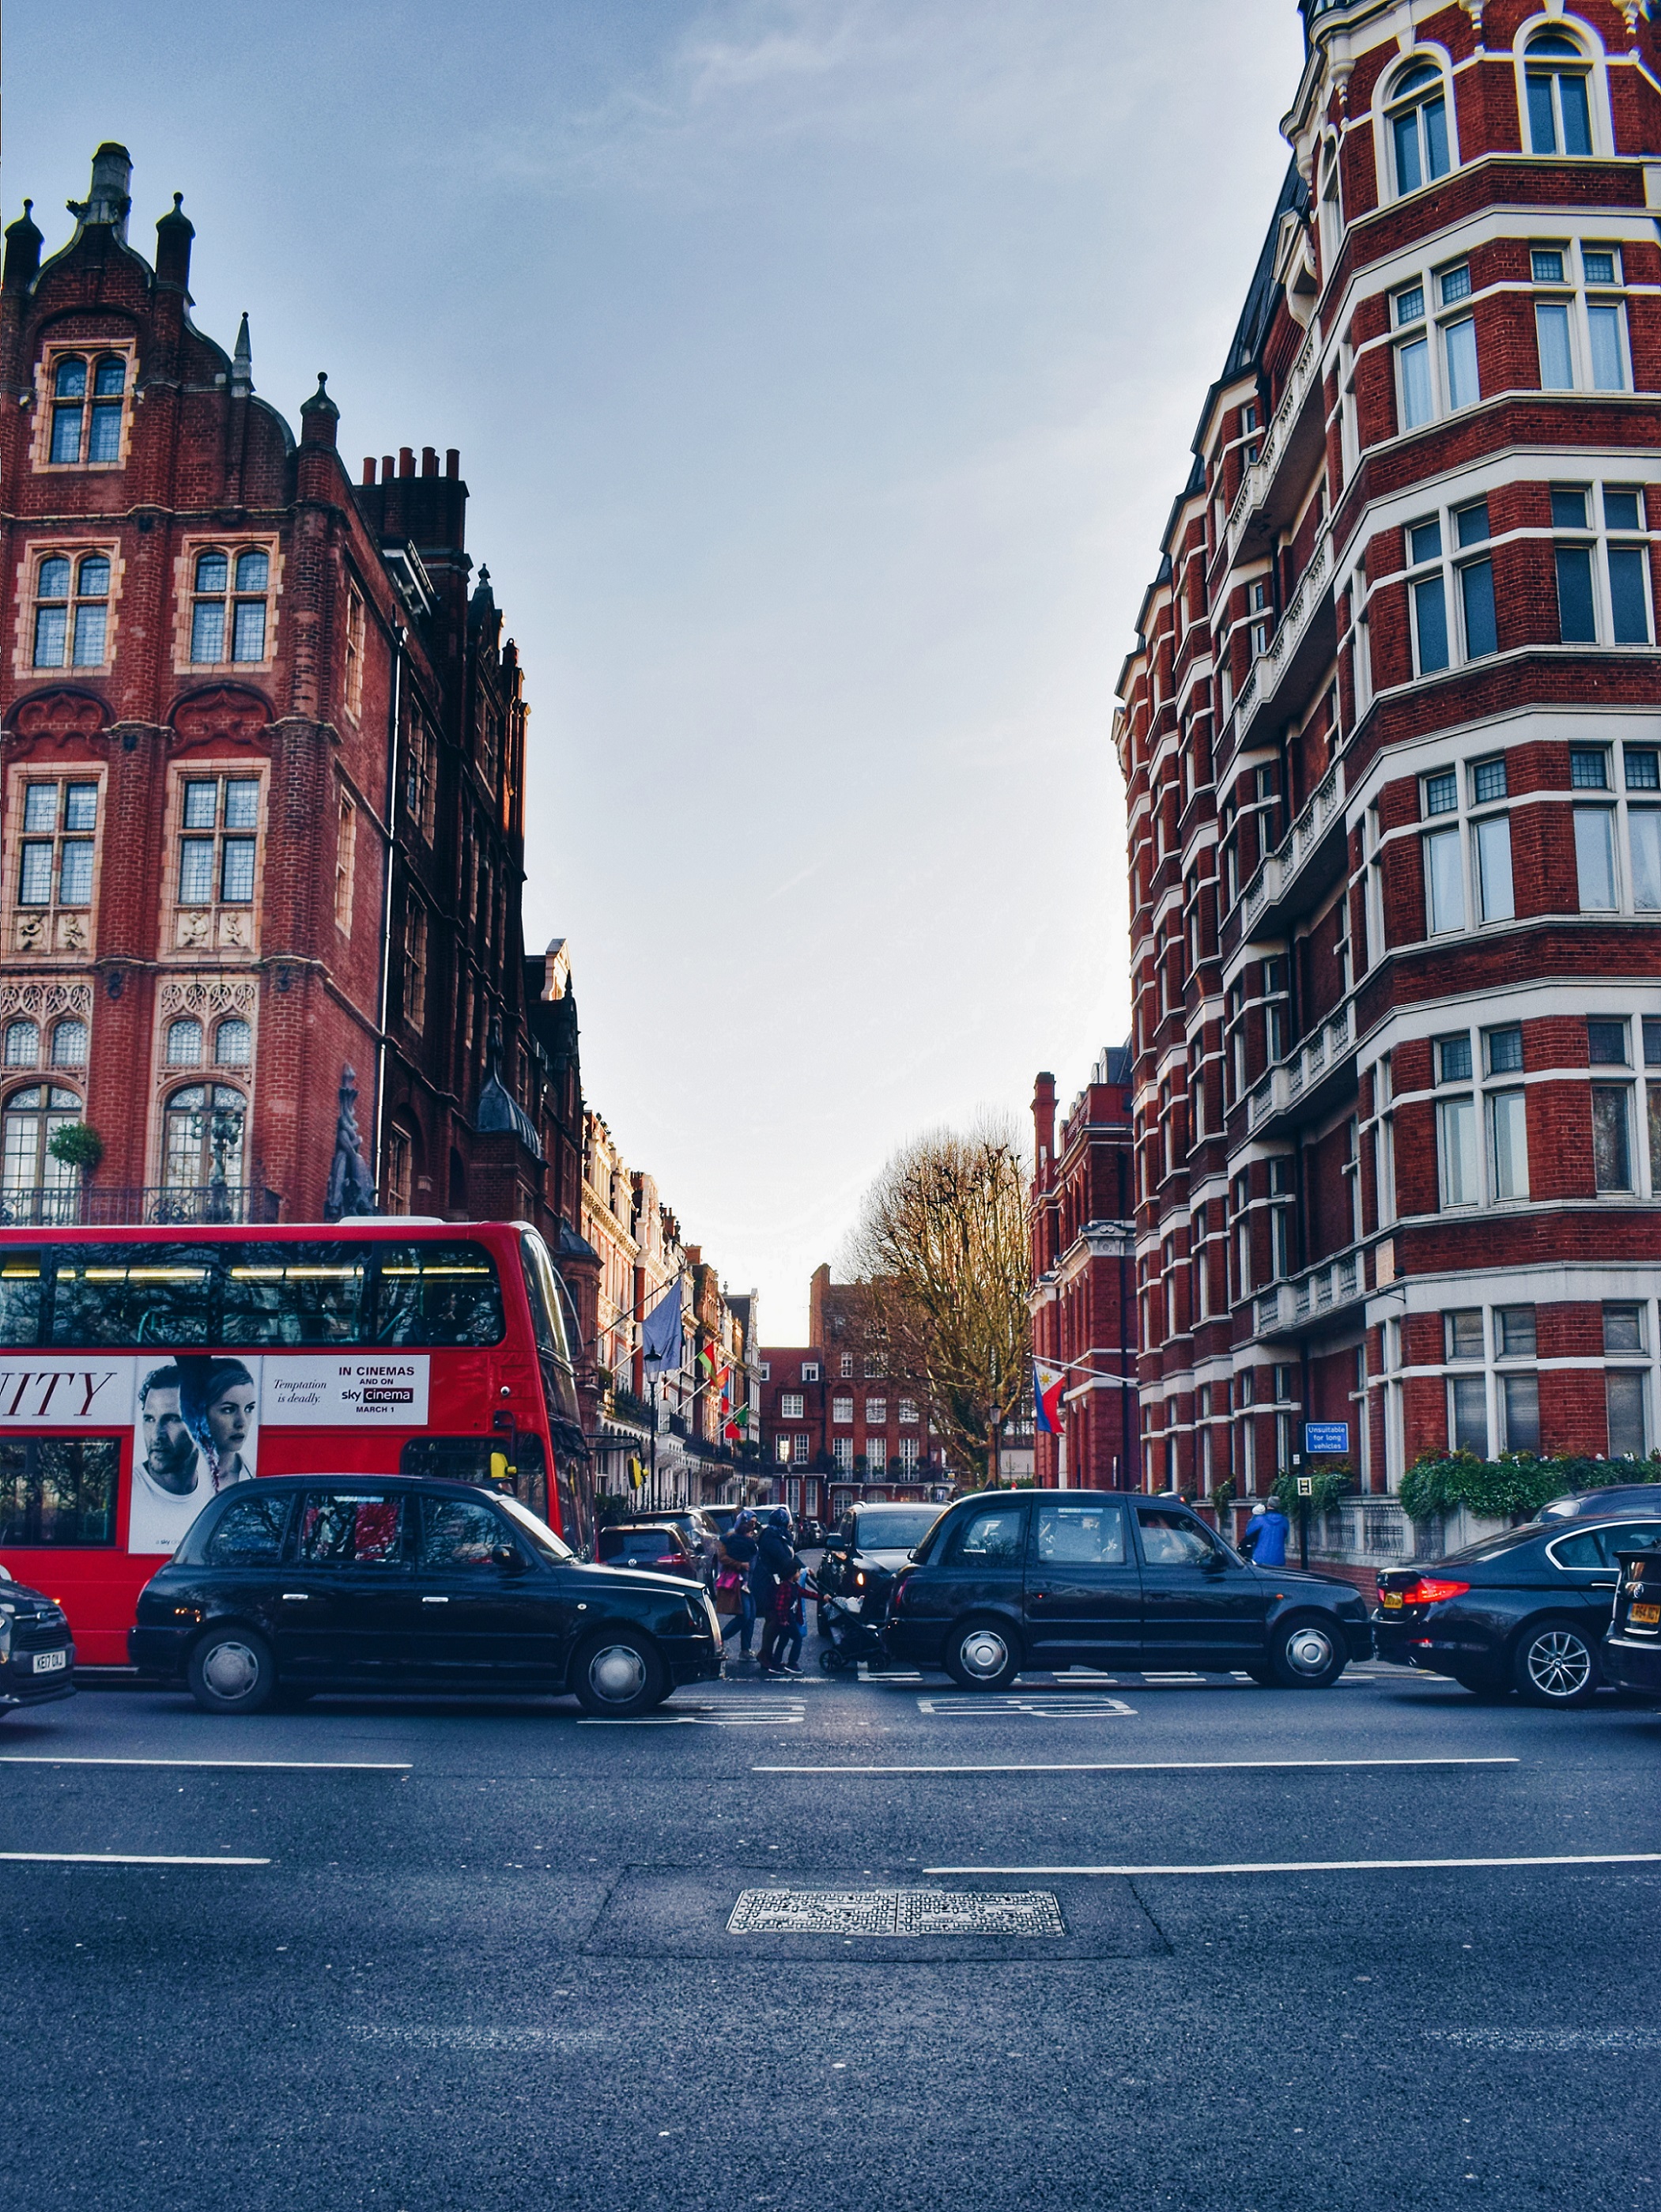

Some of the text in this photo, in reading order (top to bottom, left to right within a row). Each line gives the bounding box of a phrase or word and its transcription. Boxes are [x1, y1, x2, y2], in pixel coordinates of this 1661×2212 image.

[338, 1367, 415, 1376] IN CINEMAS
[274, 1379, 327, 1392] Temptation
[0, 1372, 118, 1416] ITY
[277, 1393, 321, 1405] is deadly.
[342, 1389, 410, 1402] sky cinema
